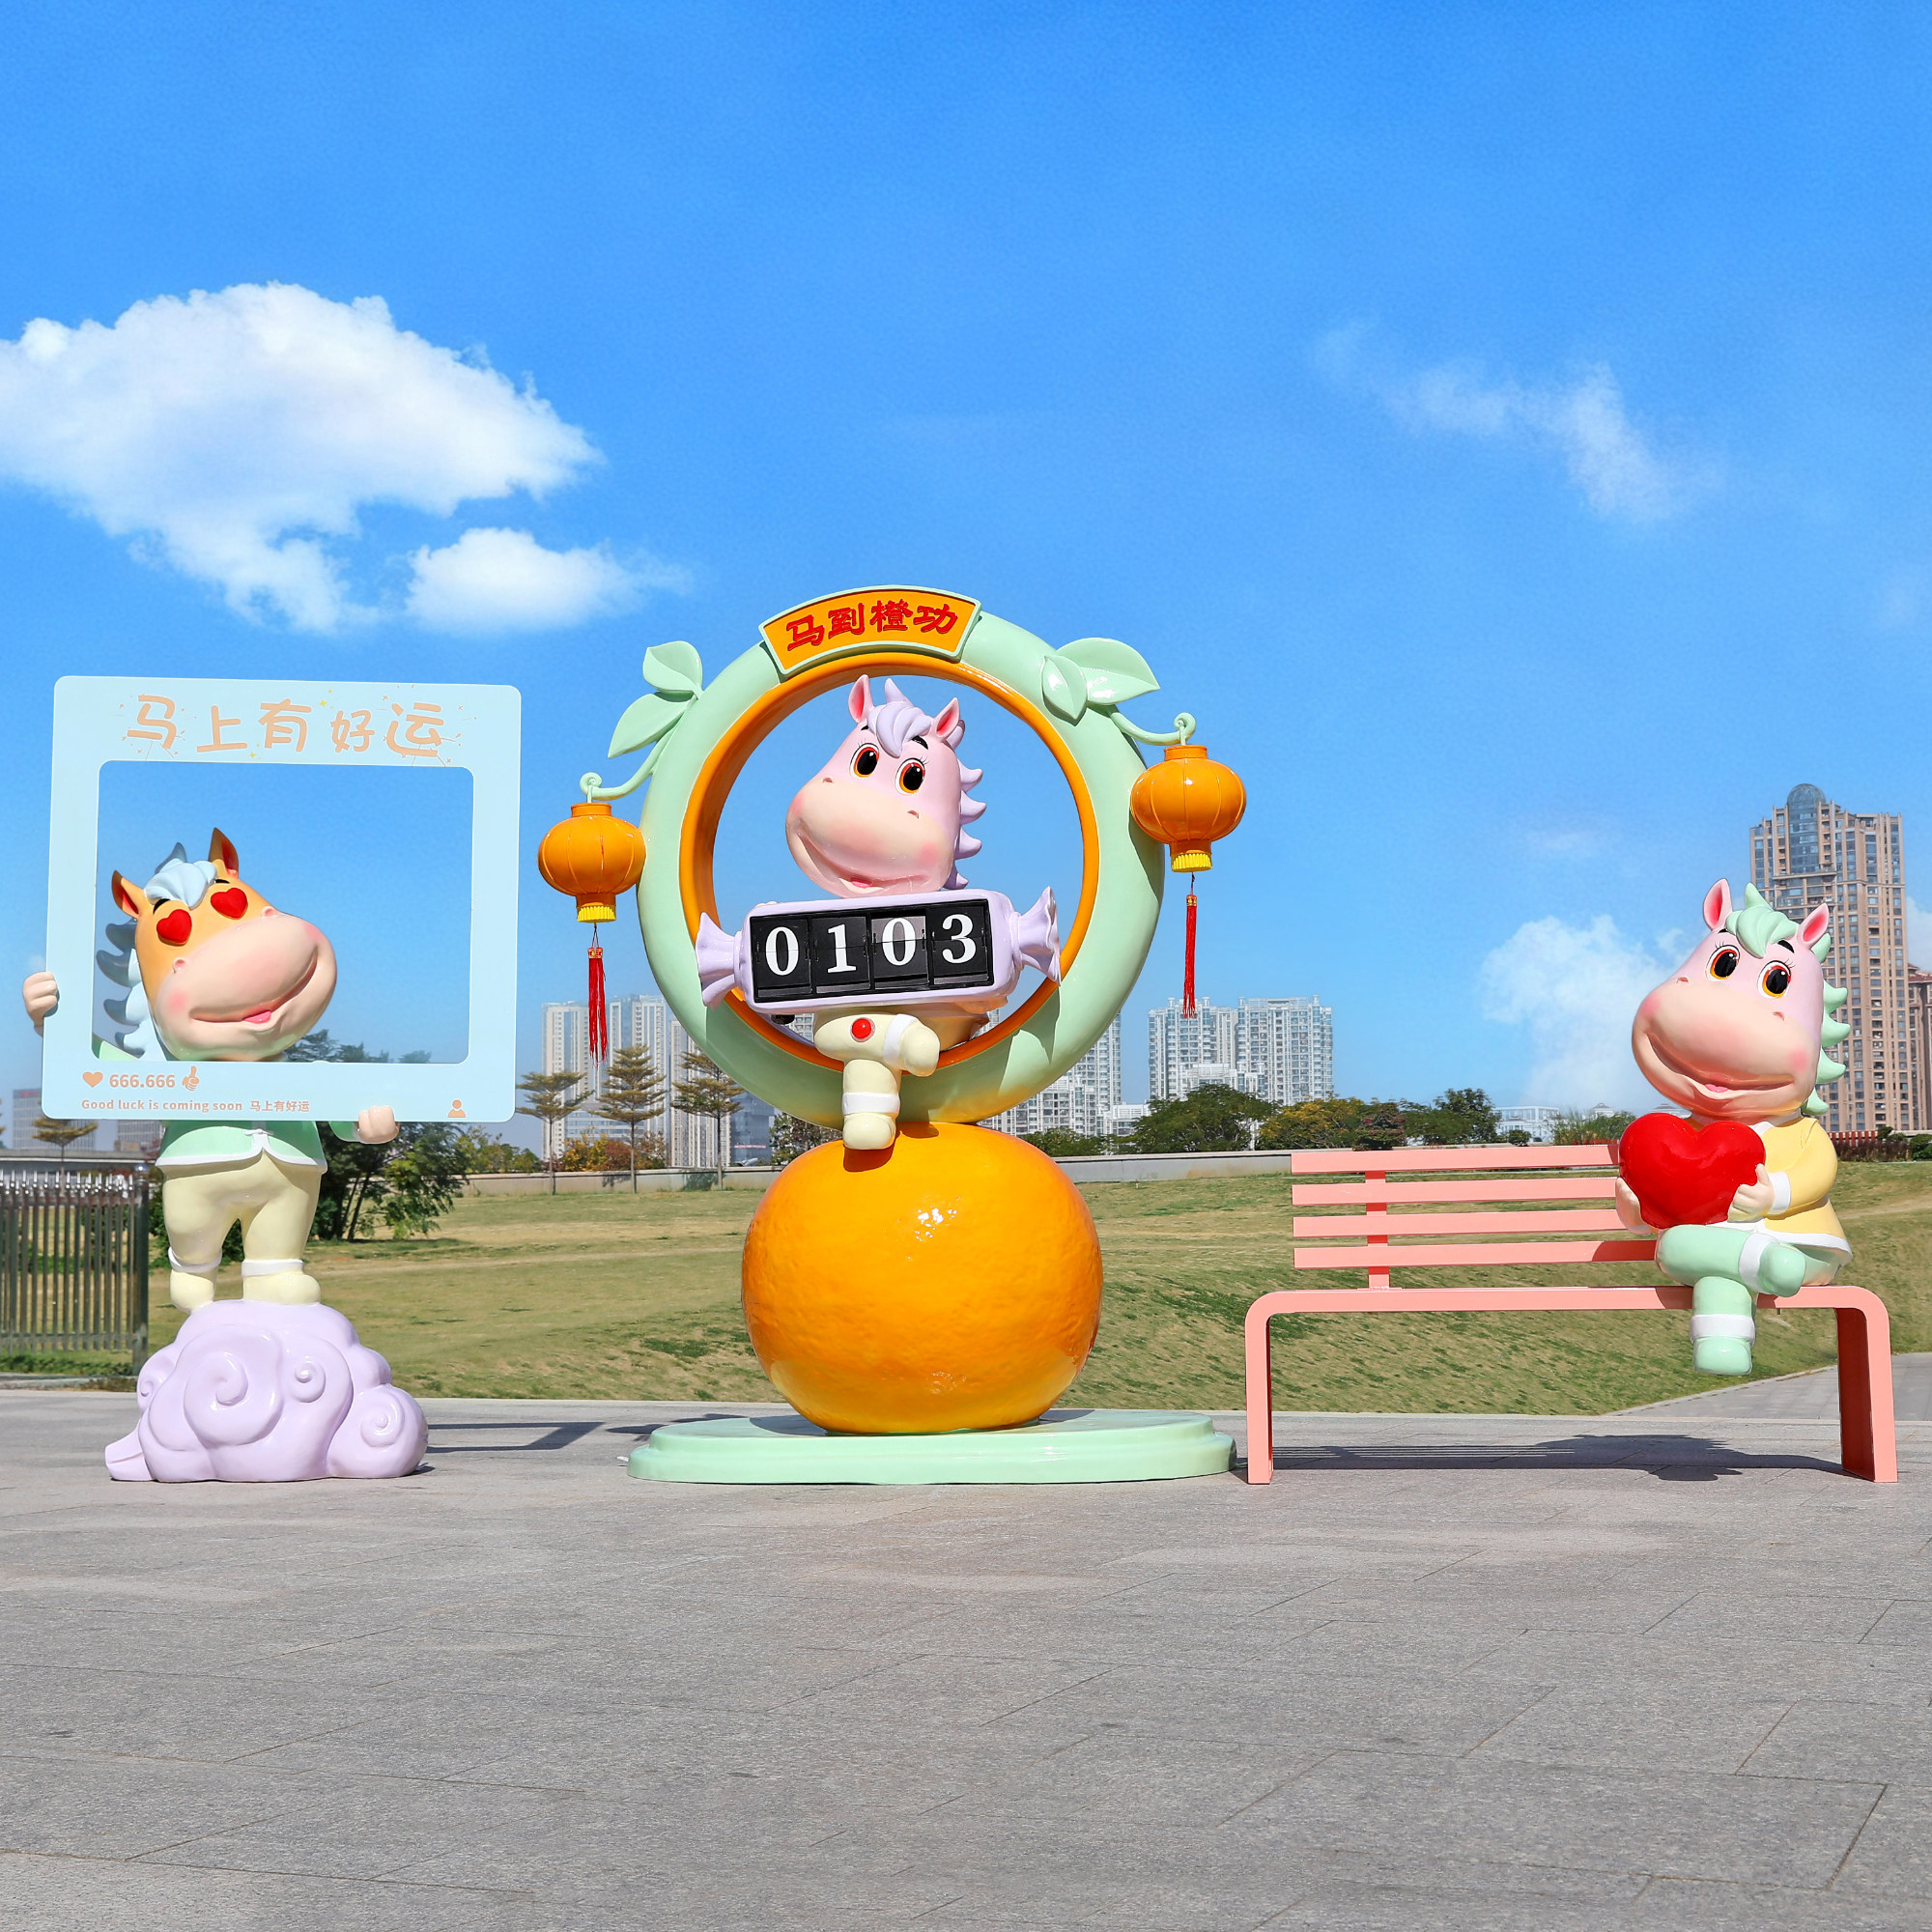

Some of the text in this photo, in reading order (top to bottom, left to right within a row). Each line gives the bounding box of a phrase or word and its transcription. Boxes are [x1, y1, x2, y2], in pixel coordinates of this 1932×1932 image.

[784, 598, 958, 652] 马到橙功
[127, 694, 445, 758] 马上有好运
[764, 914, 978, 977] 0103
[81, 1099, 114, 1110] Good
[118, 1099, 144, 1110] luck
[149, 1100, 158, 1110] is
[162, 1100, 209, 1113] coming
[249, 1100, 310, 1112] 马上有好运
[109, 1073, 176, 1088] 666.666
